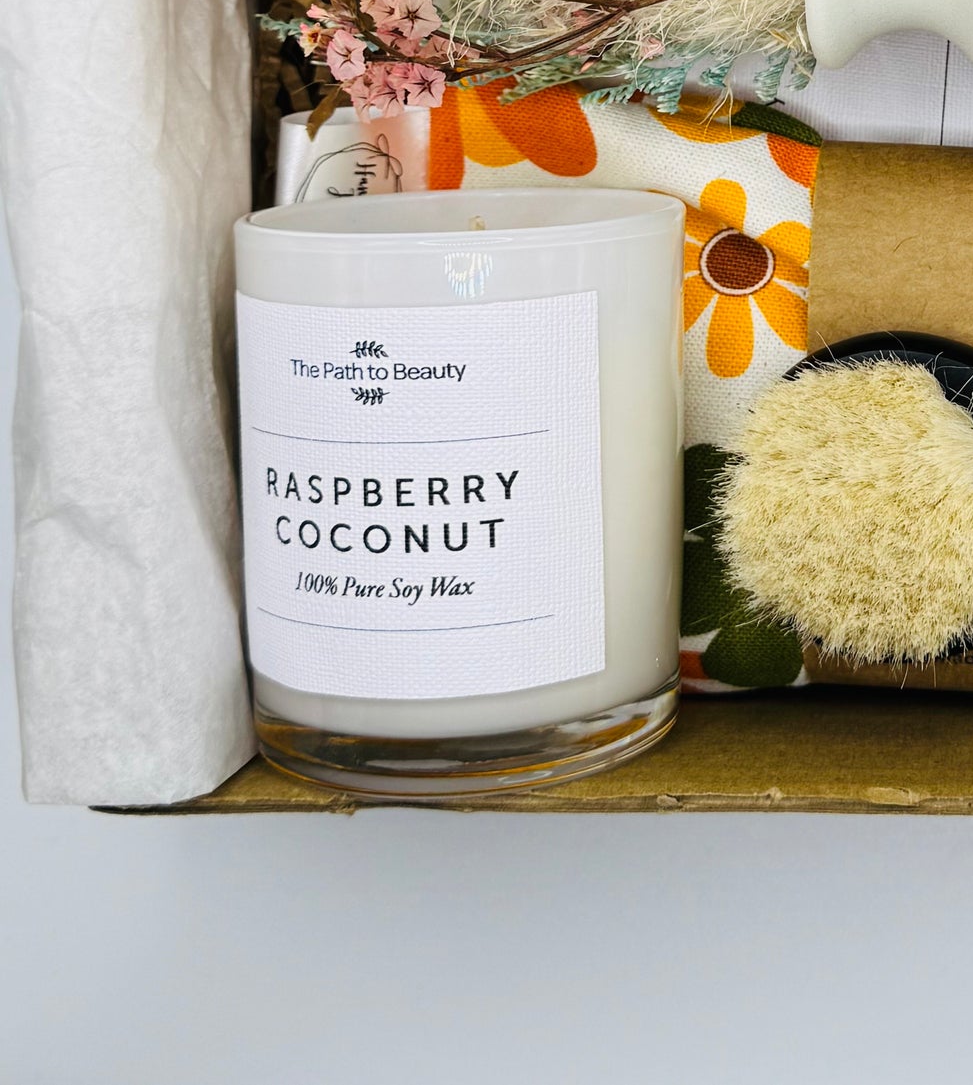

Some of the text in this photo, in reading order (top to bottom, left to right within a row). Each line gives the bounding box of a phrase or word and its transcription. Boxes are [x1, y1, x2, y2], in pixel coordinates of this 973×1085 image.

[290, 358, 467, 383] The Path to Beauty
[266, 467, 520, 507] RASPBERRY
[275, 515, 505, 554] COCONUT
[295, 571, 476, 606] 100% Pure Soy Wax
